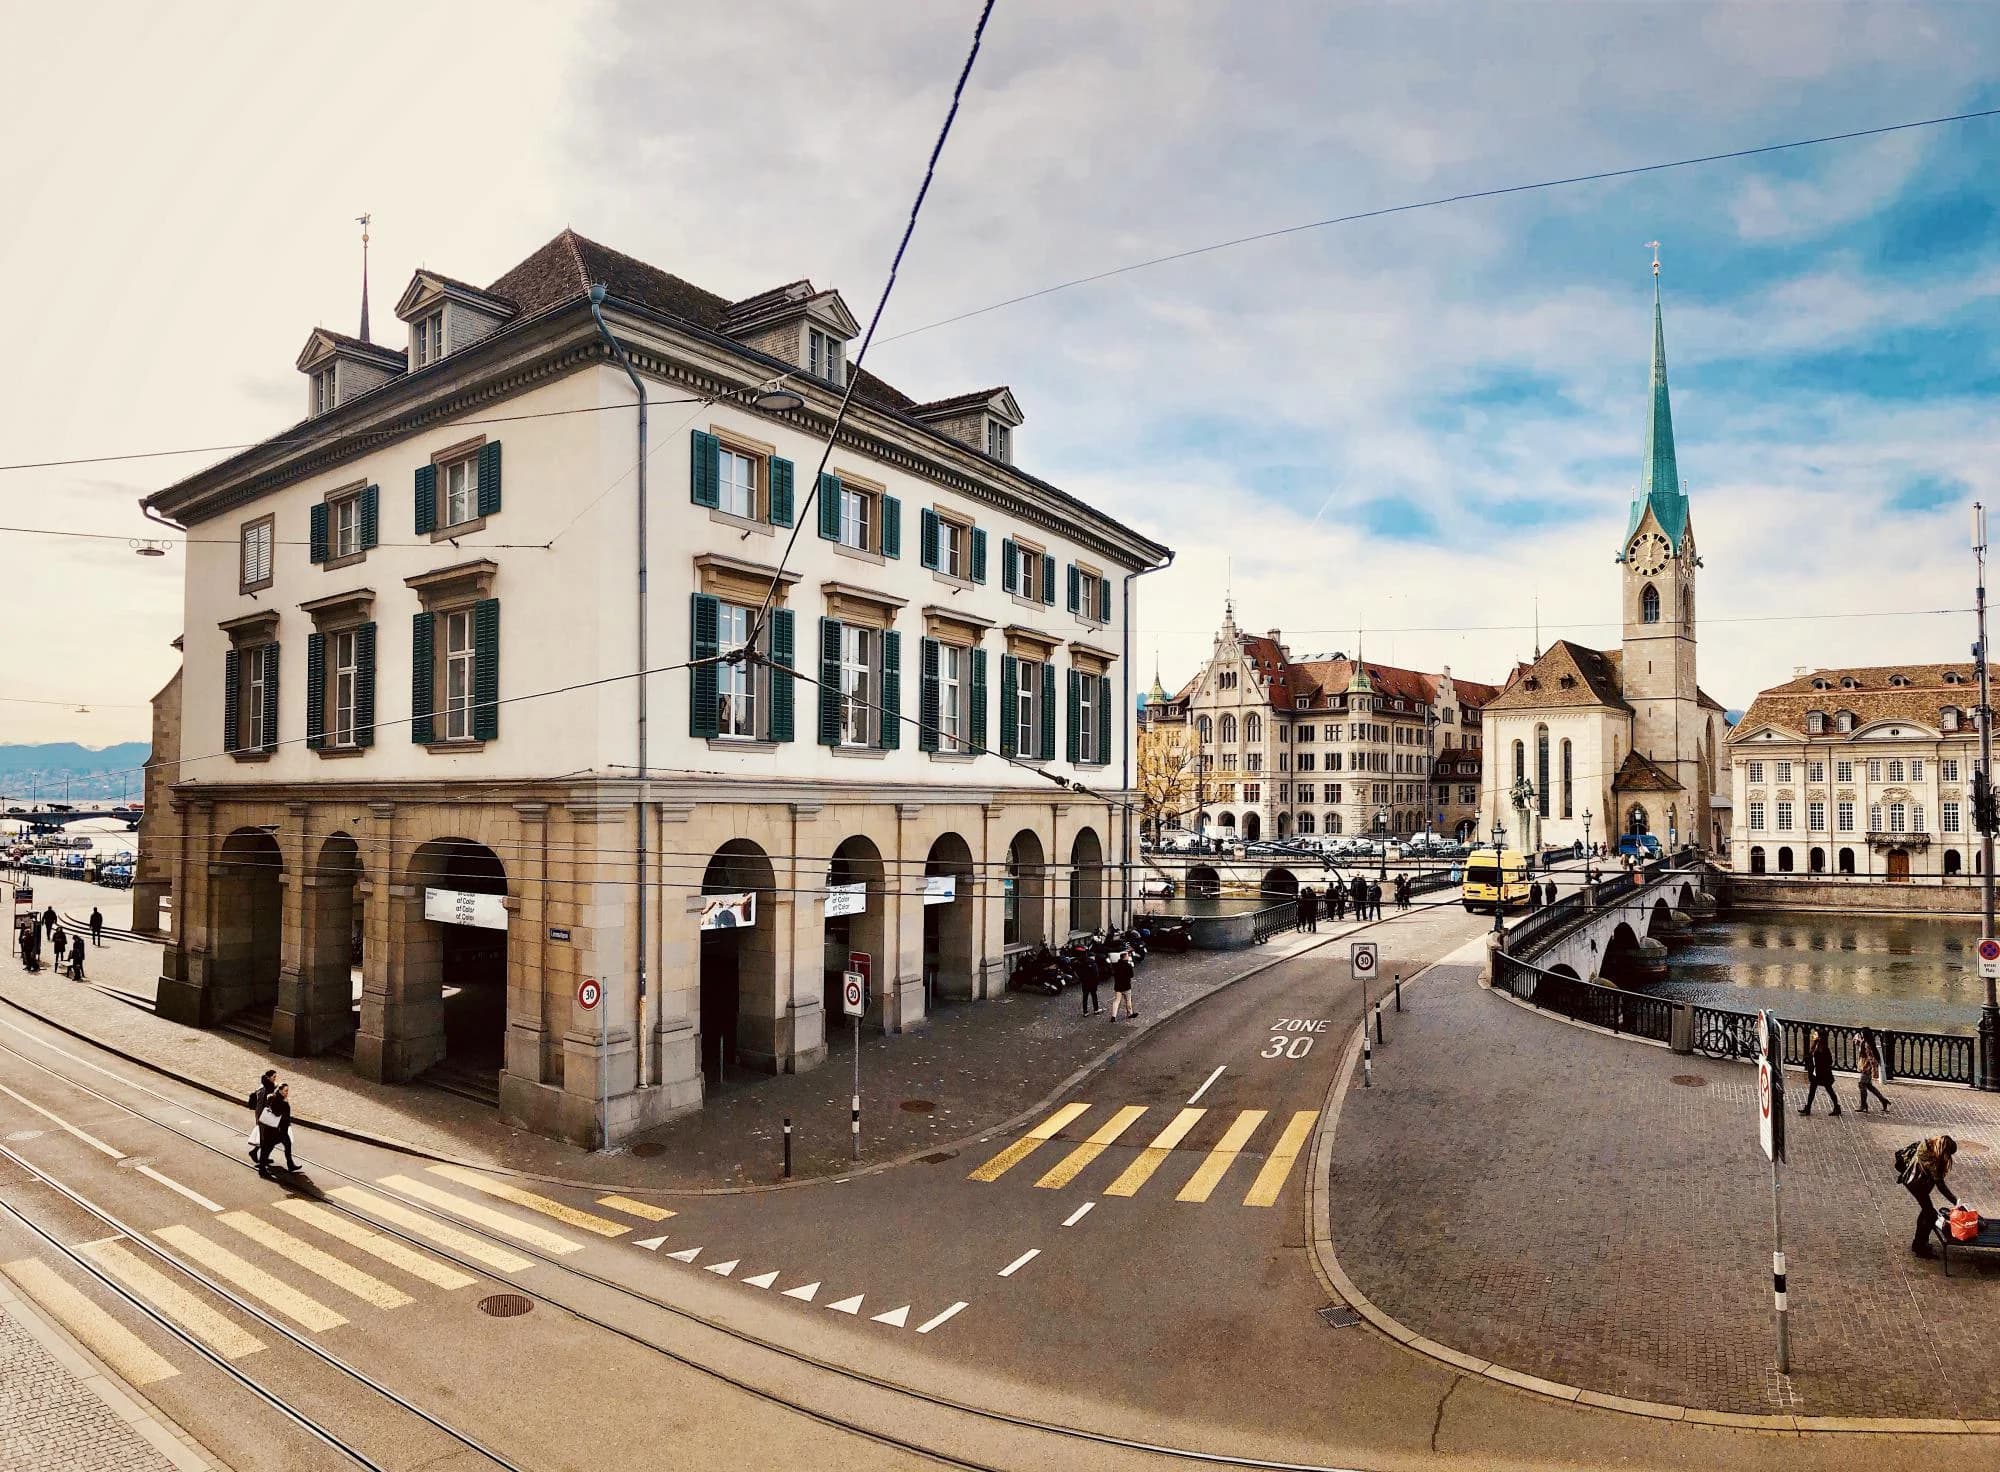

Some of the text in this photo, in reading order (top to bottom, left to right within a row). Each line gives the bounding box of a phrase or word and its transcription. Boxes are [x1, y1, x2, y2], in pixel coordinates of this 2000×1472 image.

[1360, 957, 1369, 965] 30
[585, 989, 595, 1000] 30
[850, 989, 857, 999] 30
[1270, 1018, 1332, 1033] ZONE
[1260, 1035, 1314, 1059] 30
